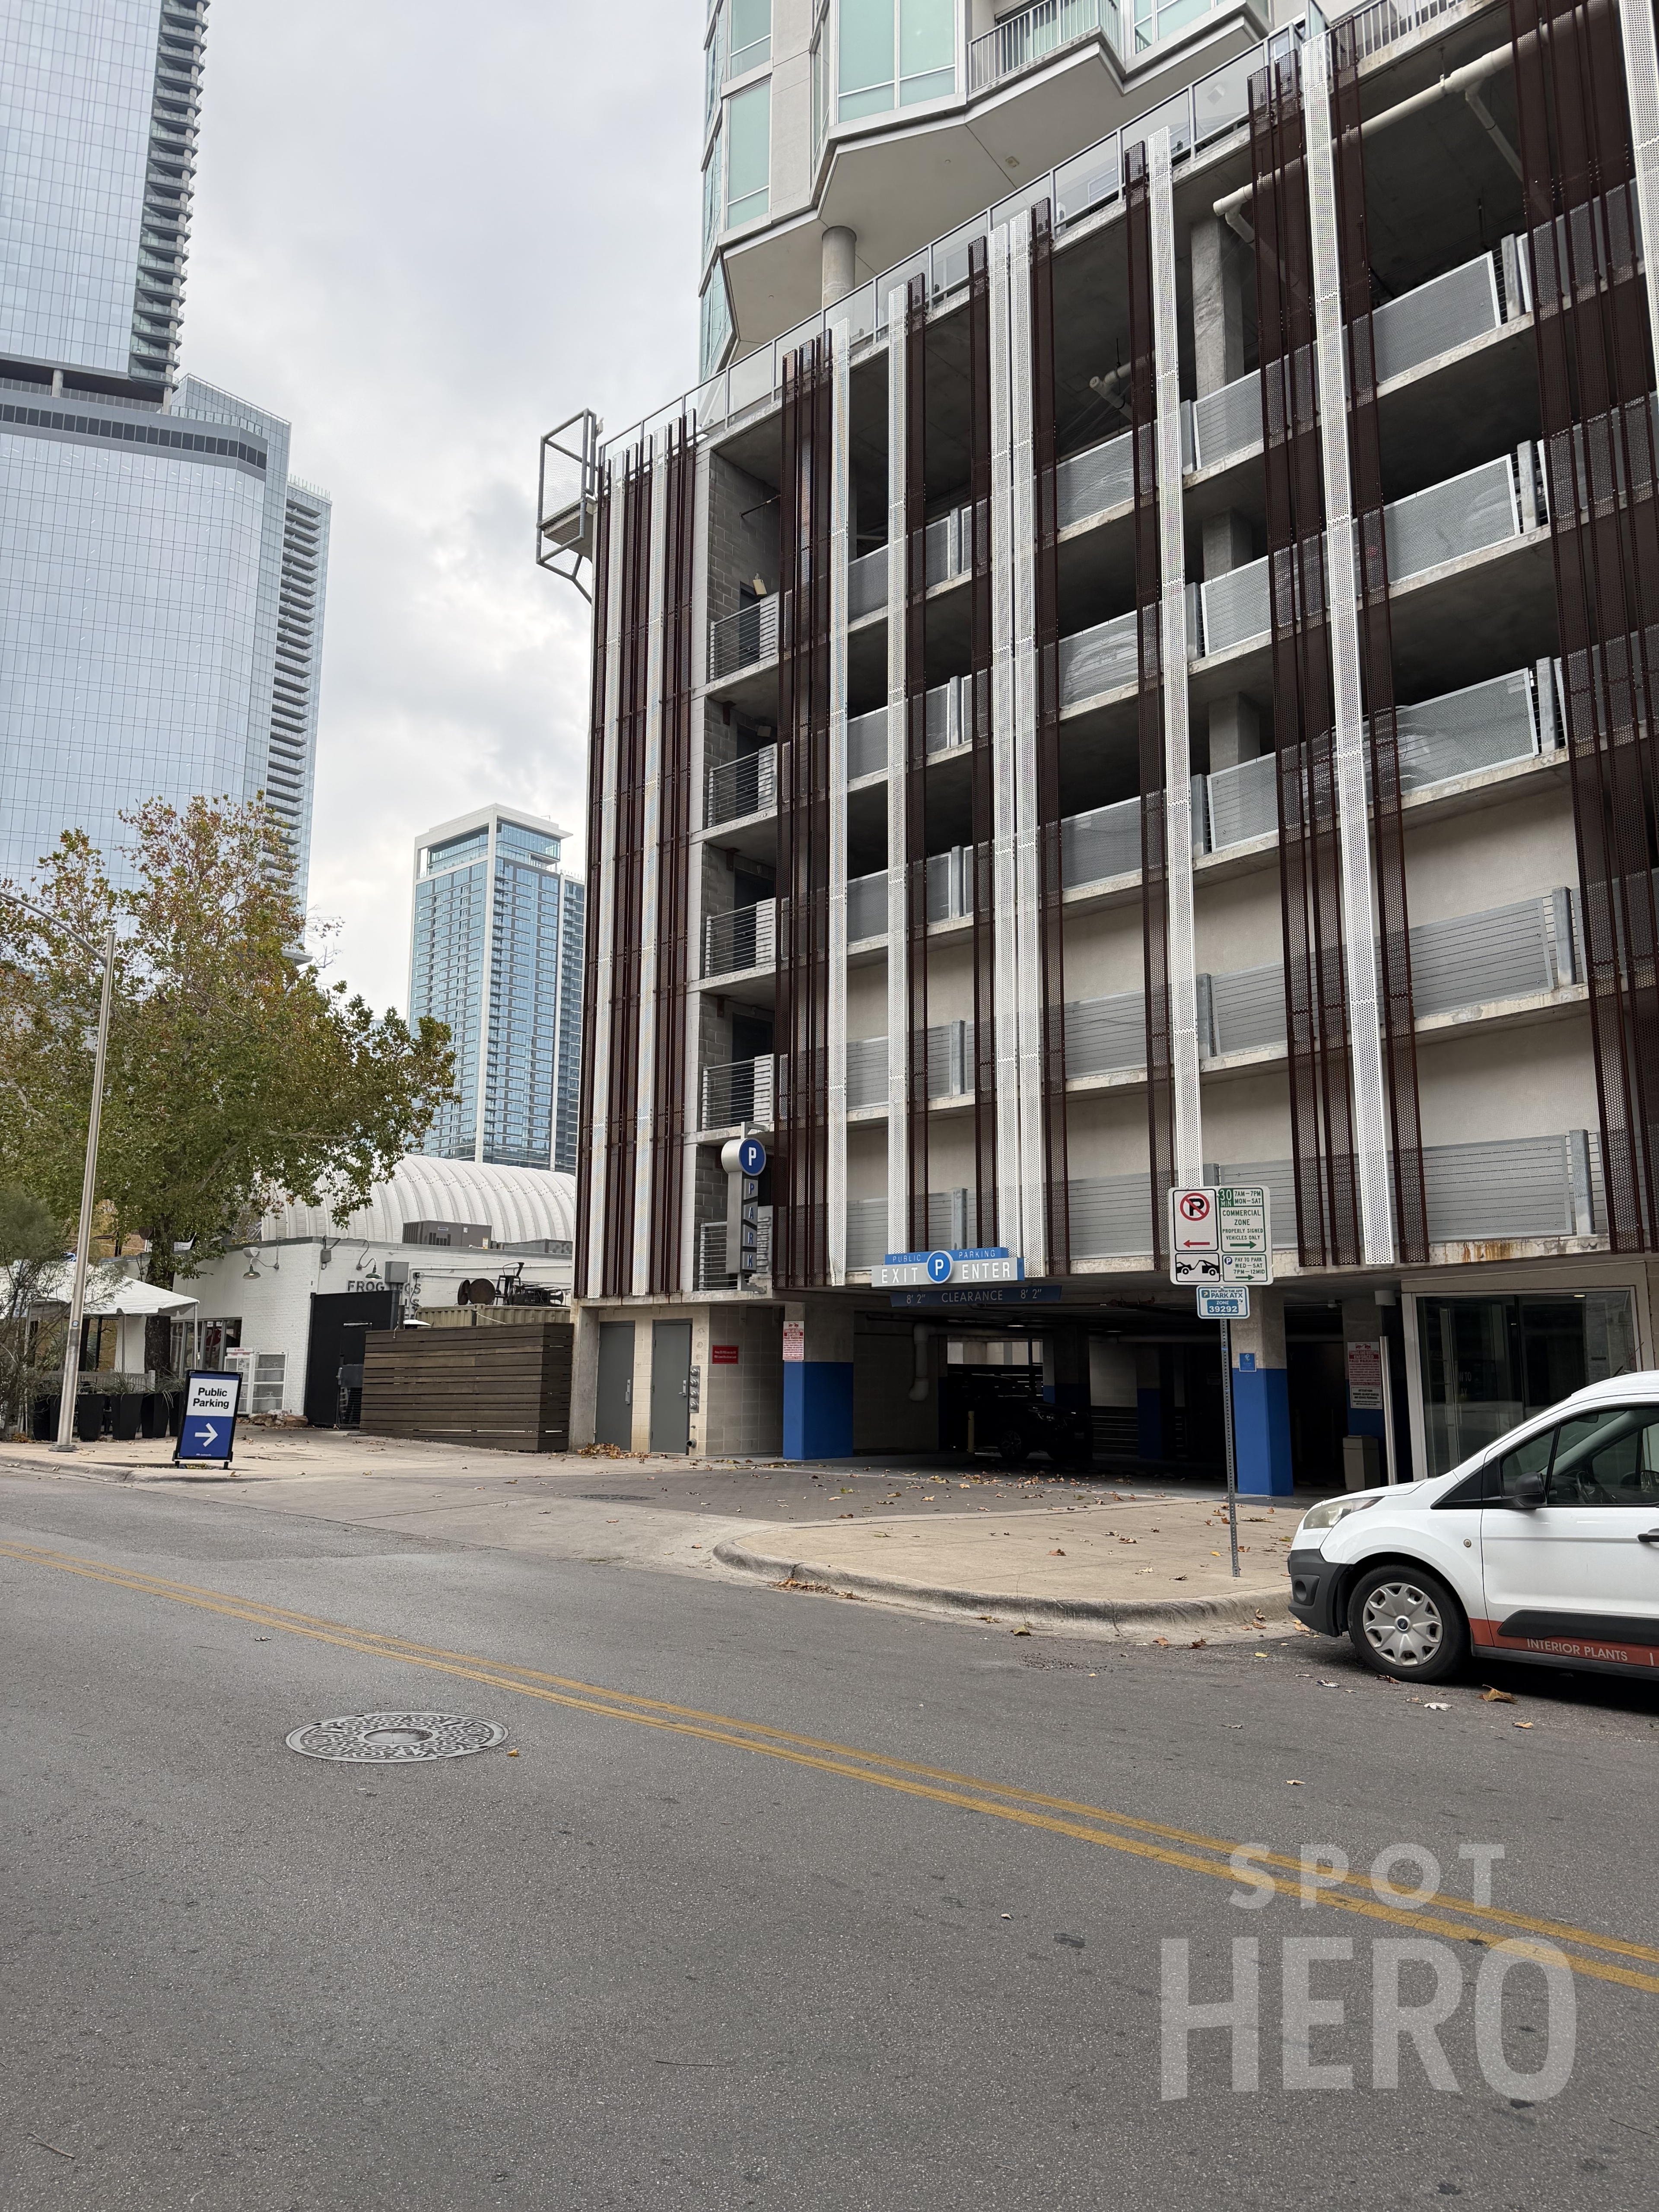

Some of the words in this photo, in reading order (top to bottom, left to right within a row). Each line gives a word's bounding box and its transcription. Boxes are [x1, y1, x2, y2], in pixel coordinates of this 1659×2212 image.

[748, 1147, 756, 1166] P
[1220, 1189, 1232, 1201] 30
[893, 1254, 921, 1263] PUBLIC
[958, 1249, 995, 1259] PARKING
[935, 1259, 944, 1276] P
[962, 1262, 1011, 1280] ENTER
[881, 1266, 918, 1284] EXIT
[347, 1280, 385, 1292] FROG
[941, 1290, 1003, 1303] CLEARANCE
[198, 1387, 227, 1397] Public
[193, 1398, 229, 1409] Parking
[1527, 1638, 1580, 1655] INTERIOR
[1584, 1646, 1628, 1661] PLANTS
